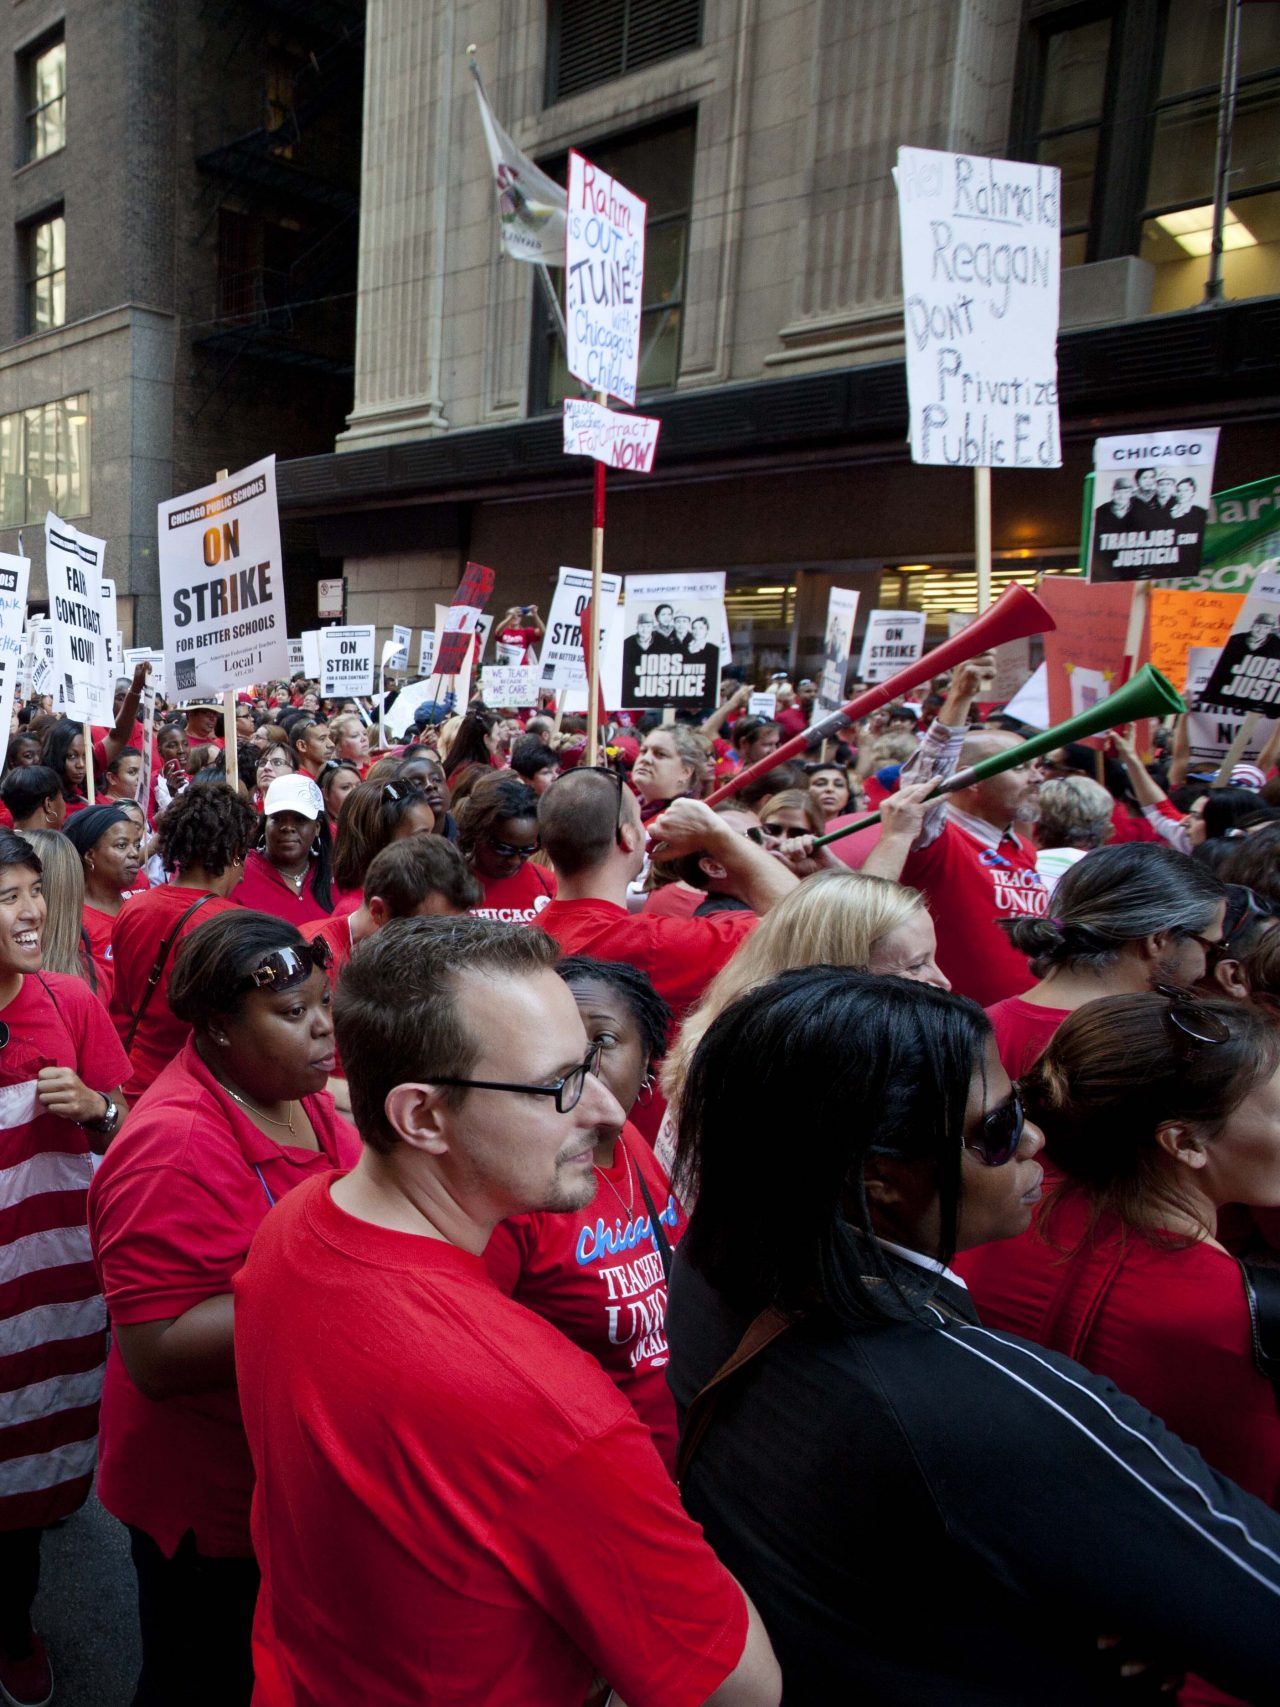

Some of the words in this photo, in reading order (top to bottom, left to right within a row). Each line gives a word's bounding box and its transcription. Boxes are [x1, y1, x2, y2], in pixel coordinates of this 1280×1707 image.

[583, 160, 633, 237] Rahm
[585, 218, 623, 261] OUT
[624, 240, 639, 275] of
[570, 258, 634, 307] TUNE
[937, 347, 1057, 405] Privatize
[922, 404, 1005, 466] Public
[612, 438, 651, 469] NOW
[1113, 444, 1201, 460] CHICAGO
[171, 506, 205, 526] CHICAGO
[206, 496, 232, 515] PUBLIC
[233, 479, 264, 504] SCHOOLS
[203, 519, 240, 567] ON
[1099, 529, 1175, 551] TRABAJOS
[1112, 546, 1179, 567] JUSTICIA
[66, 566, 87, 597] FAIR
[173, 561, 272, 627] STRIKE
[56, 596, 101, 636] CONTRACT
[176, 637, 194, 653] FOR
[196, 628, 231, 648] BETTER
[232, 614, 275, 640] SCHOOLS
[340, 641, 356, 654] ON
[885, 628, 903, 641] ON
[70, 635, 95, 666] NOW!
[224, 653, 253, 672] Local
[258, 651, 262, 663] 1
[293, 646, 301, 654] ON
[871, 645, 917, 658] STRIKE
[326, 659, 369, 672] STRIKE
[509, 669, 528, 678] TEACH
[635, 653, 683, 676] JOBS
[683, 664, 706, 675] WITH
[178, 679, 196, 689] UNION
[509, 685, 527, 694] CARE
[634, 675, 705, 697] JUSTICE
[1221, 676, 1280, 703] JUST
[994, 885, 1048, 915] UNIO
[469, 908, 537, 922] HICAG
[599, 1251, 665, 1300] TEACHE
[605, 1288, 668, 1344] UNIO
